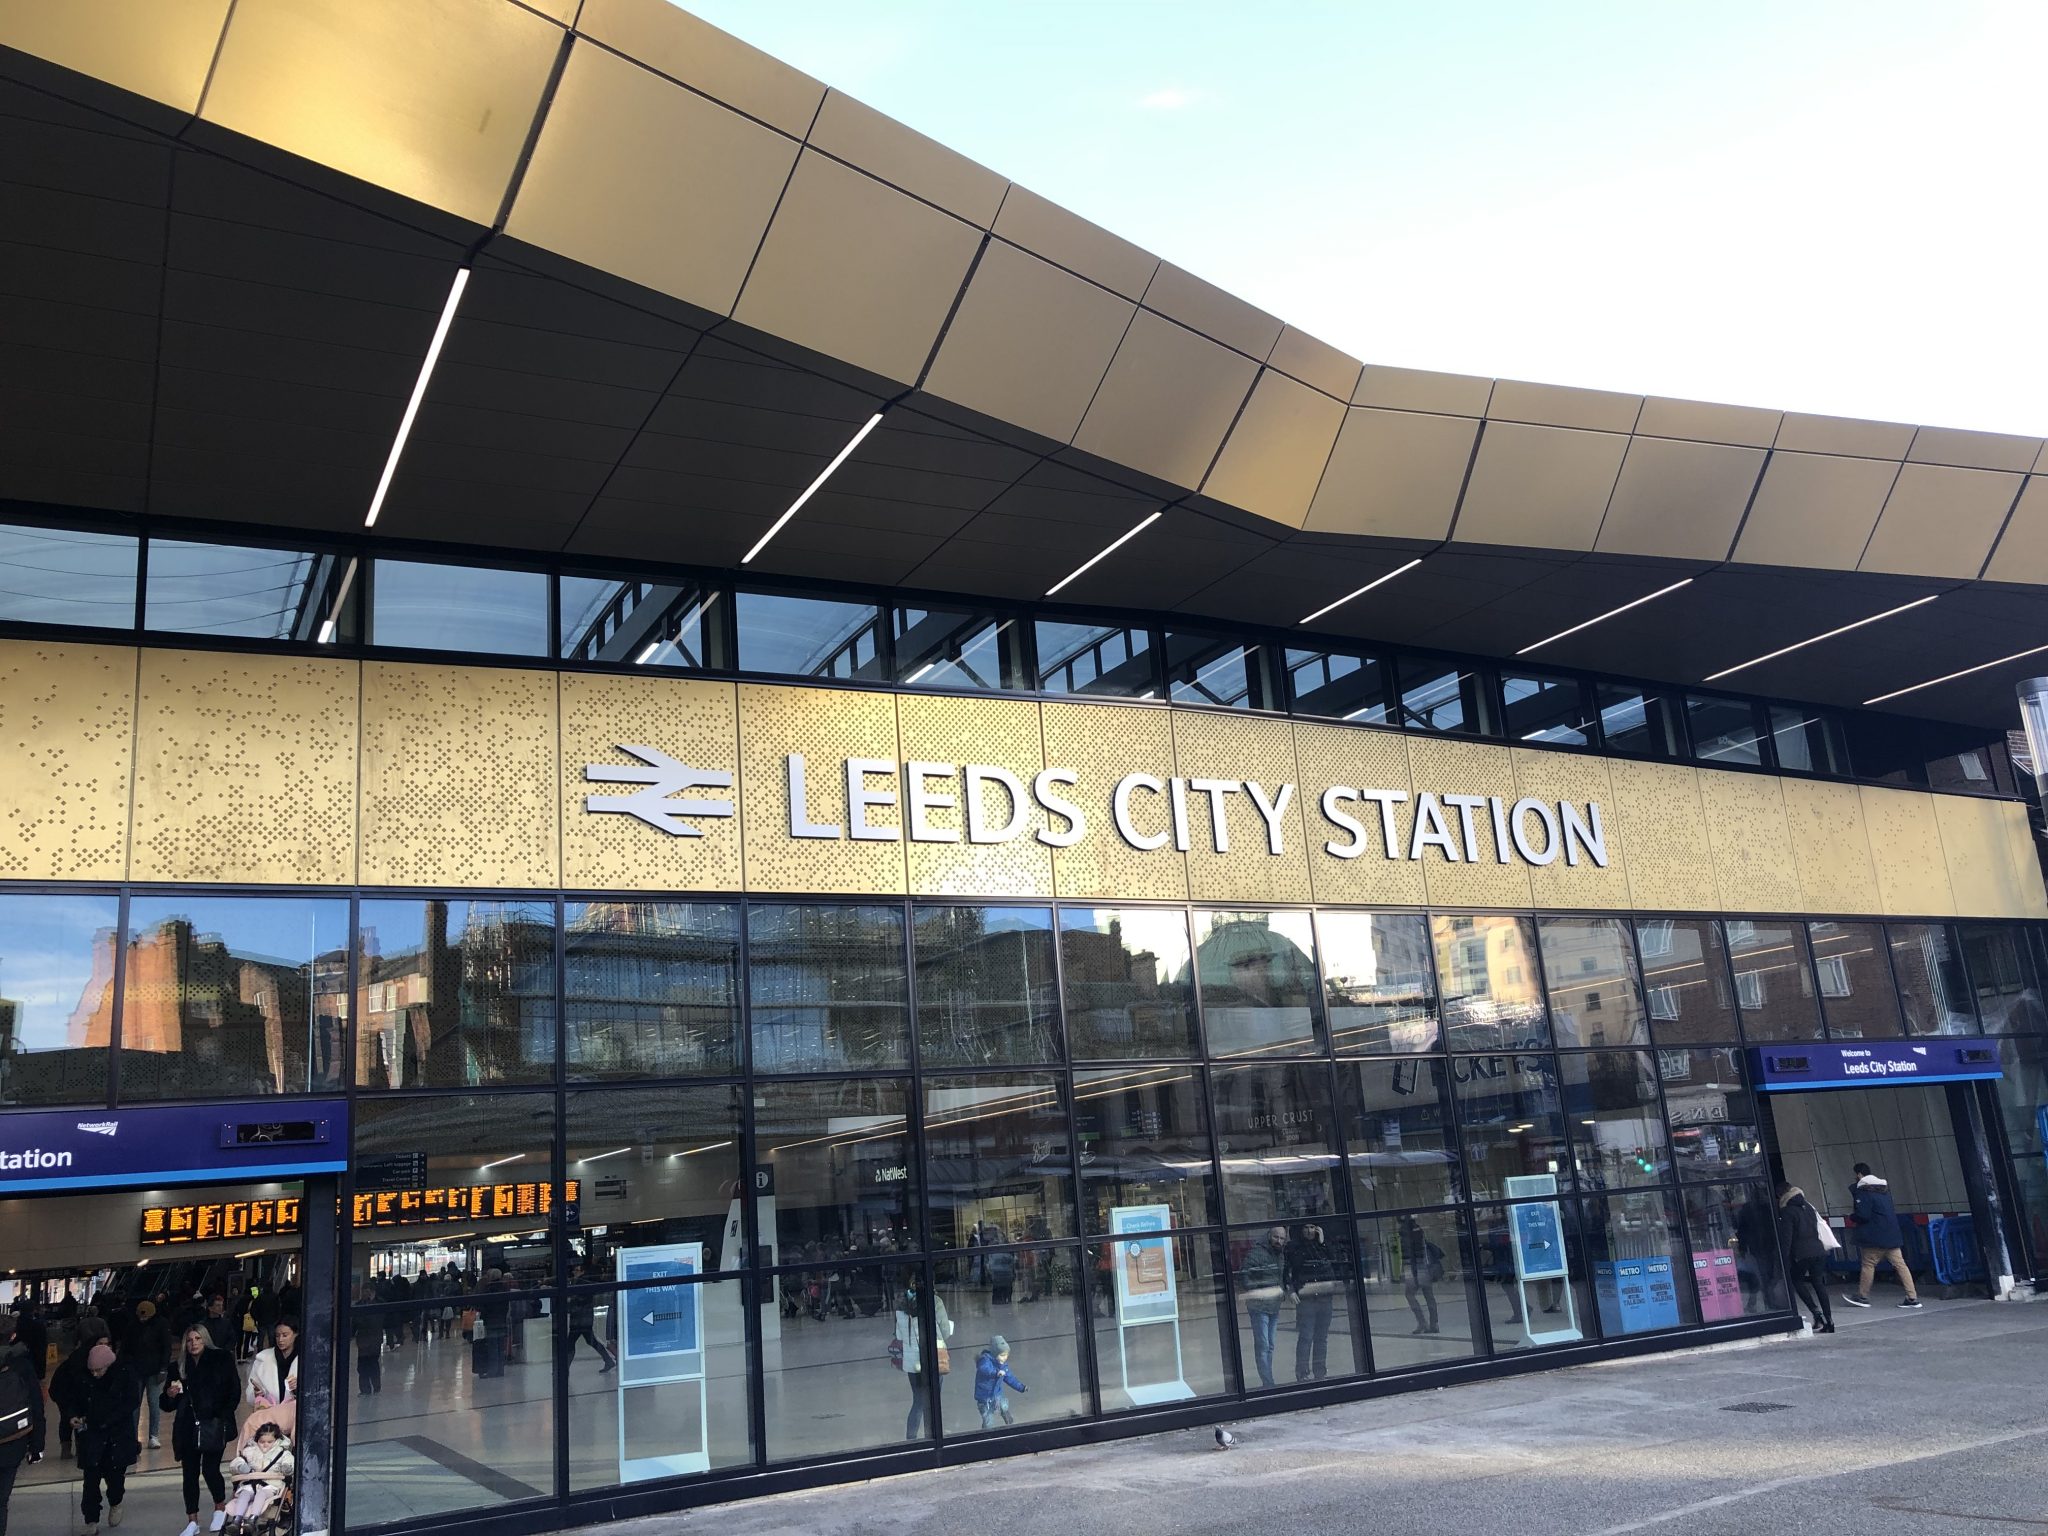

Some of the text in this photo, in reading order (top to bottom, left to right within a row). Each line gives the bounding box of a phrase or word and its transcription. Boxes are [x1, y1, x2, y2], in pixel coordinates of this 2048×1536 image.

[785, 752, 1609, 868] LEEDS CITY STATION
[1840, 1049, 1864, 1057] Welcome
[1843, 1060, 1917, 1075] Leeds City Station
[1247, 1109, 1313, 1129] UPPER CRUST
[0, 1148, 72, 1170] tation
[881, 1164, 908, 1182] NatWest
[1714, 1256, 1732, 1266] METRO
[1619, 1266, 1640, 1276] METRO
[1647, 1263, 1668, 1273] METRO
[652, 1270, 668, 1279] EXIT
[645, 1284, 677, 1294] THIS WAY
